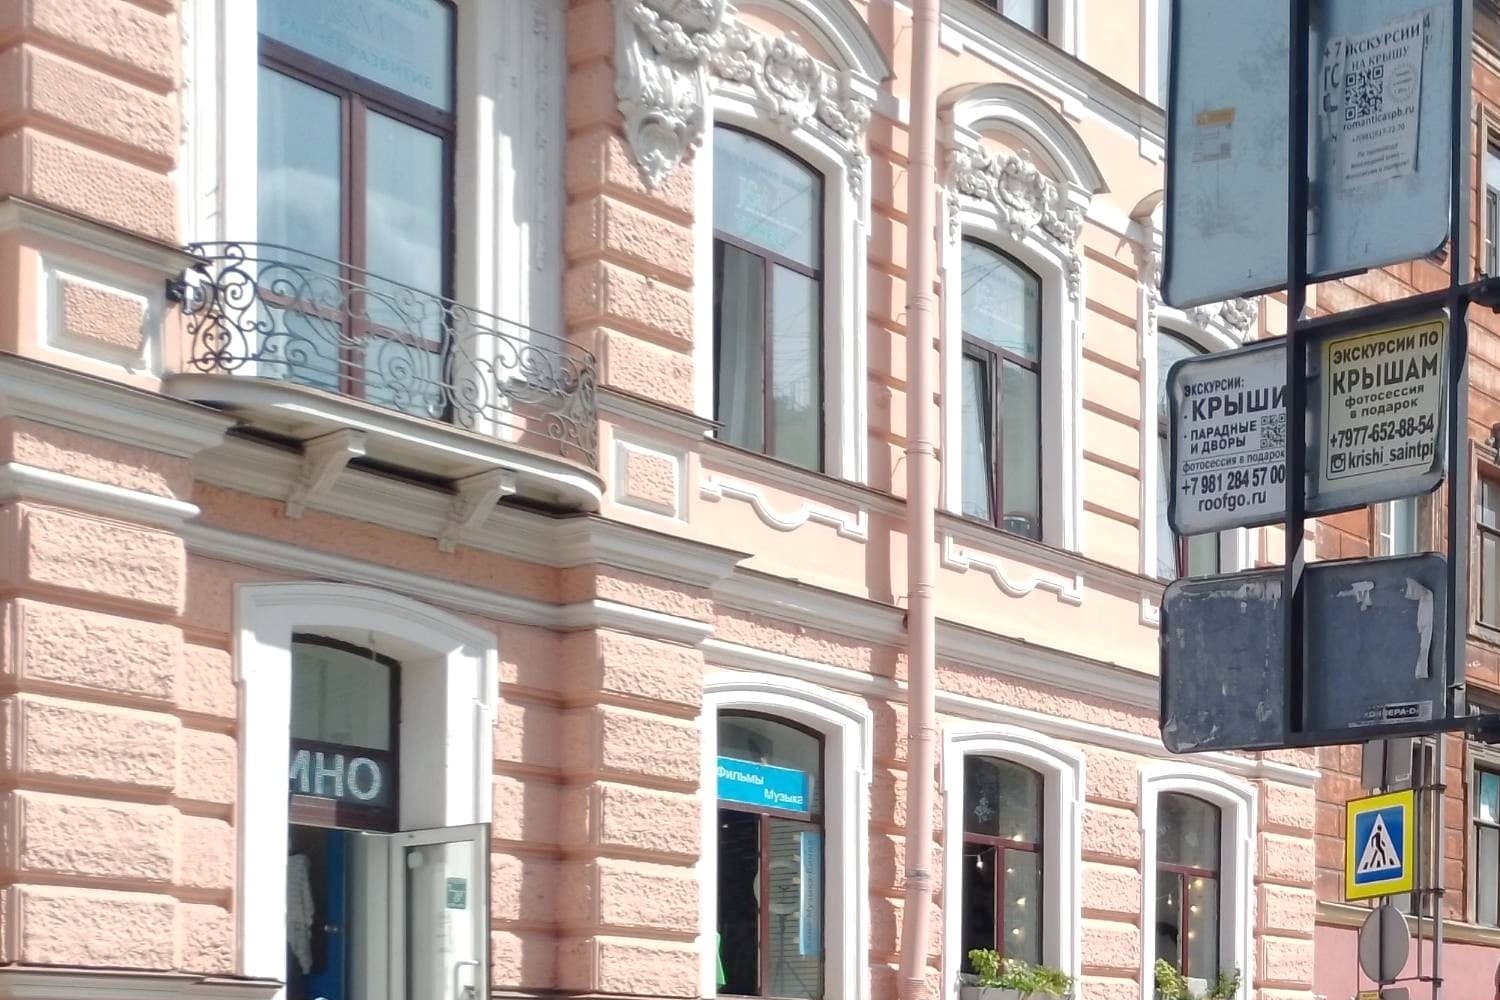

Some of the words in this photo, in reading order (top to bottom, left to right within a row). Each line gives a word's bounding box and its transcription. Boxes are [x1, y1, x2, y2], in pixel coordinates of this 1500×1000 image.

[1369, 46, 1409, 66] КРЫШУ
[1333, 336, 1415, 364] ЭКСКУРСИИ
[1419, 331, 1439, 348] ПО
[1333, 352, 1438, 396] КРЫШАМ
[1184, 377, 1244, 398] ЭКСКУРСИИ:
[1345, 384, 1425, 409] фотосессия
[1192, 385, 1287, 421] КРЫШИ
[1350, 410, 1357, 419] в
[1361, 398, 1418, 417] подарок
[1191, 420, 1257, 441] ПАРАДНЫЕ
[1330, 413, 1434, 449] +7977-652-88-54
[1190, 443, 1198, 455] И
[1201, 436, 1246, 455] ДВОРЫ
[1183, 456, 1236, 474] фотосессия
[1239, 455, 1245, 464] в
[1247, 450, 1285, 463] подарок
[1181, 477, 1198, 495] +7
[1201, 473, 1222, 494] 981
[1227, 470, 1249, 490] 284
[1252, 467, 1268, 487] 57
[1270, 464, 1285, 484] 00
[1198, 490, 1267, 512] roofgo.ru
[764, 788, 804, 804] Музыка
